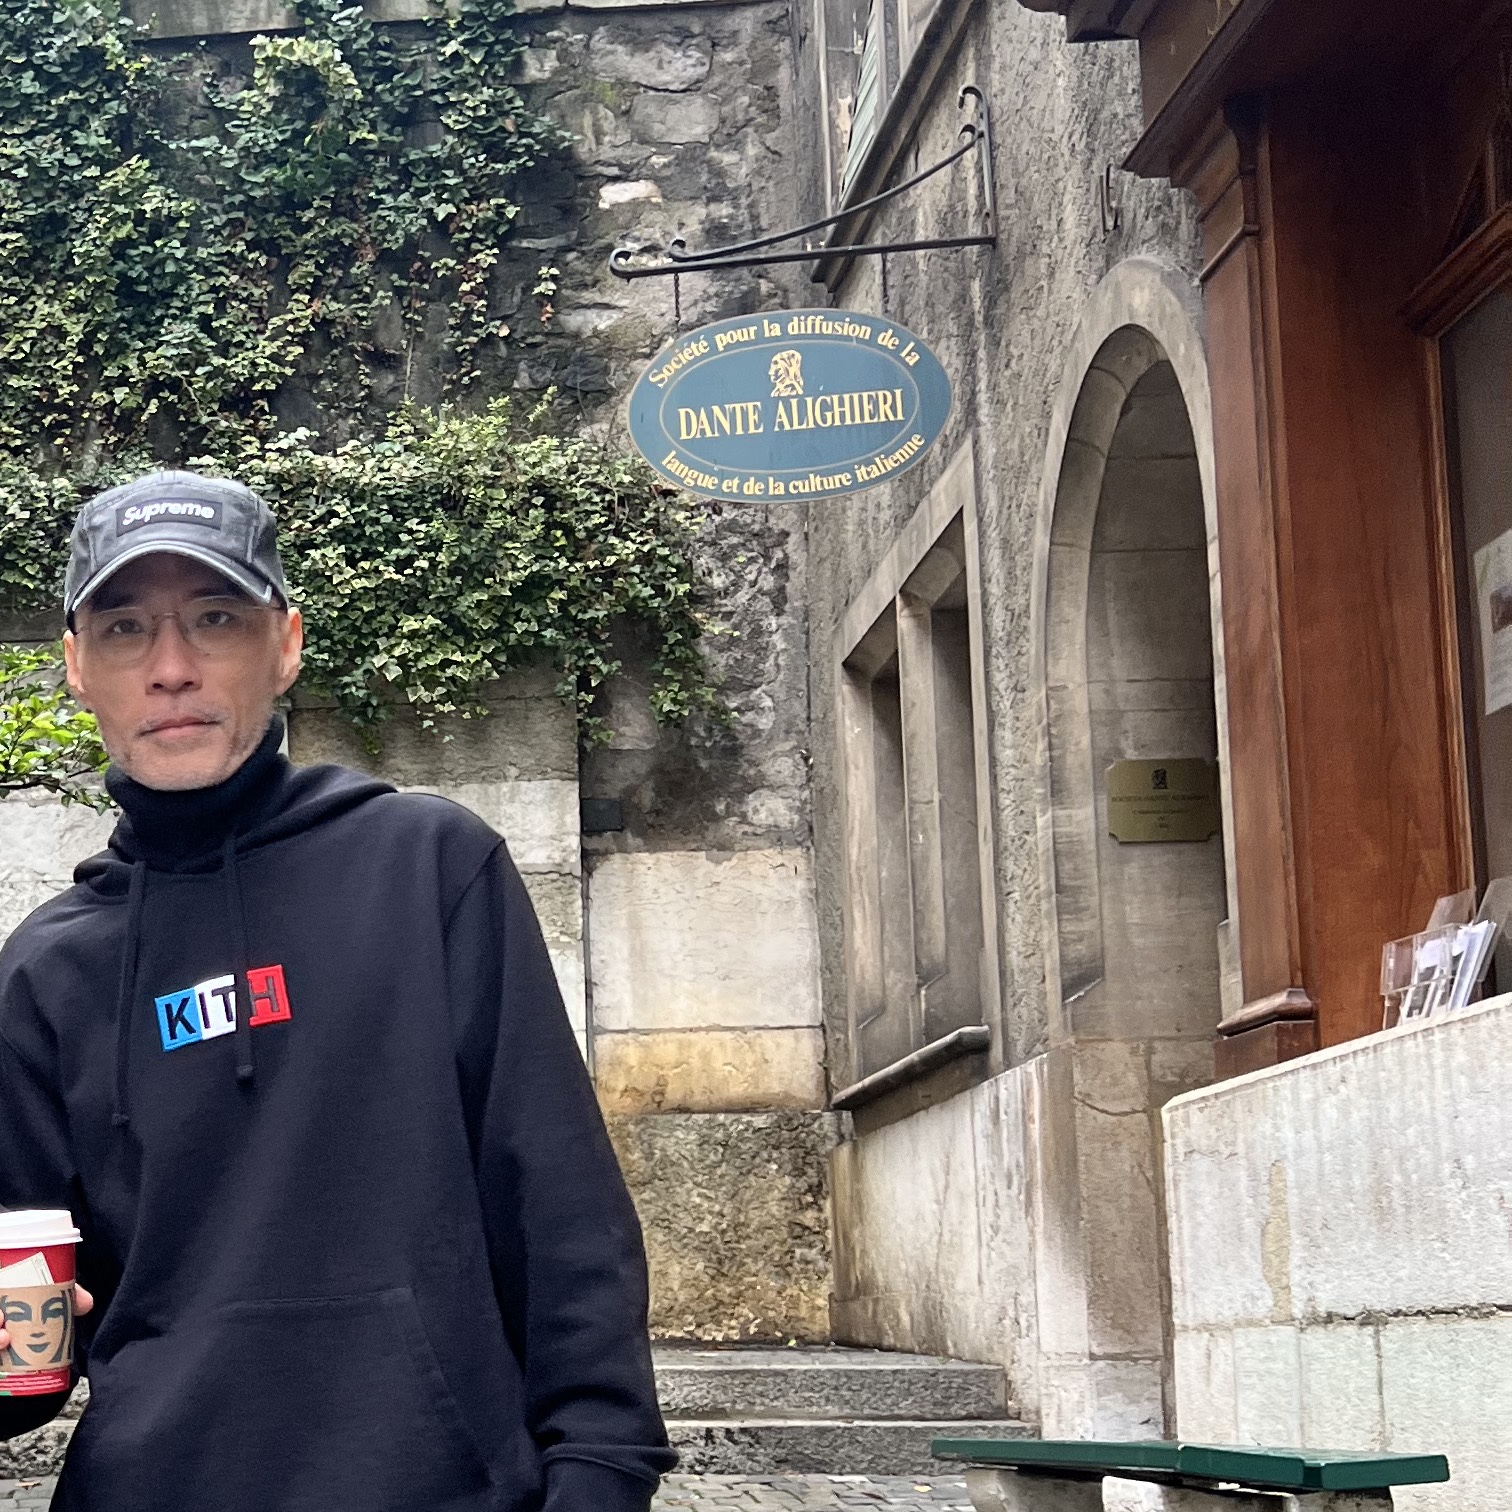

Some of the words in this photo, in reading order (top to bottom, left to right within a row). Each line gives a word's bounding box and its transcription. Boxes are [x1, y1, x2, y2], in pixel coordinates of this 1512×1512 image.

[649, 335, 709, 388] Société
[714, 325, 757, 351] pour
[763, 319, 781, 338] la
[787, 315, 871, 340] diffusion
[877, 328, 899, 350] de
[899, 341, 920, 366] la
[678, 401, 763, 440] DANTE
[774, 388, 905, 432] ALIGHIERI
[661, 450, 718, 490] langue
[722, 476, 740, 493] et
[743, 476, 765, 495] de
[768, 476, 785, 495] la
[788, 472, 852, 494] culture
[854, 433, 925, 482] italienne
[122, 502, 215, 526] Supreme
[164, 975, 280, 1040] KITH
